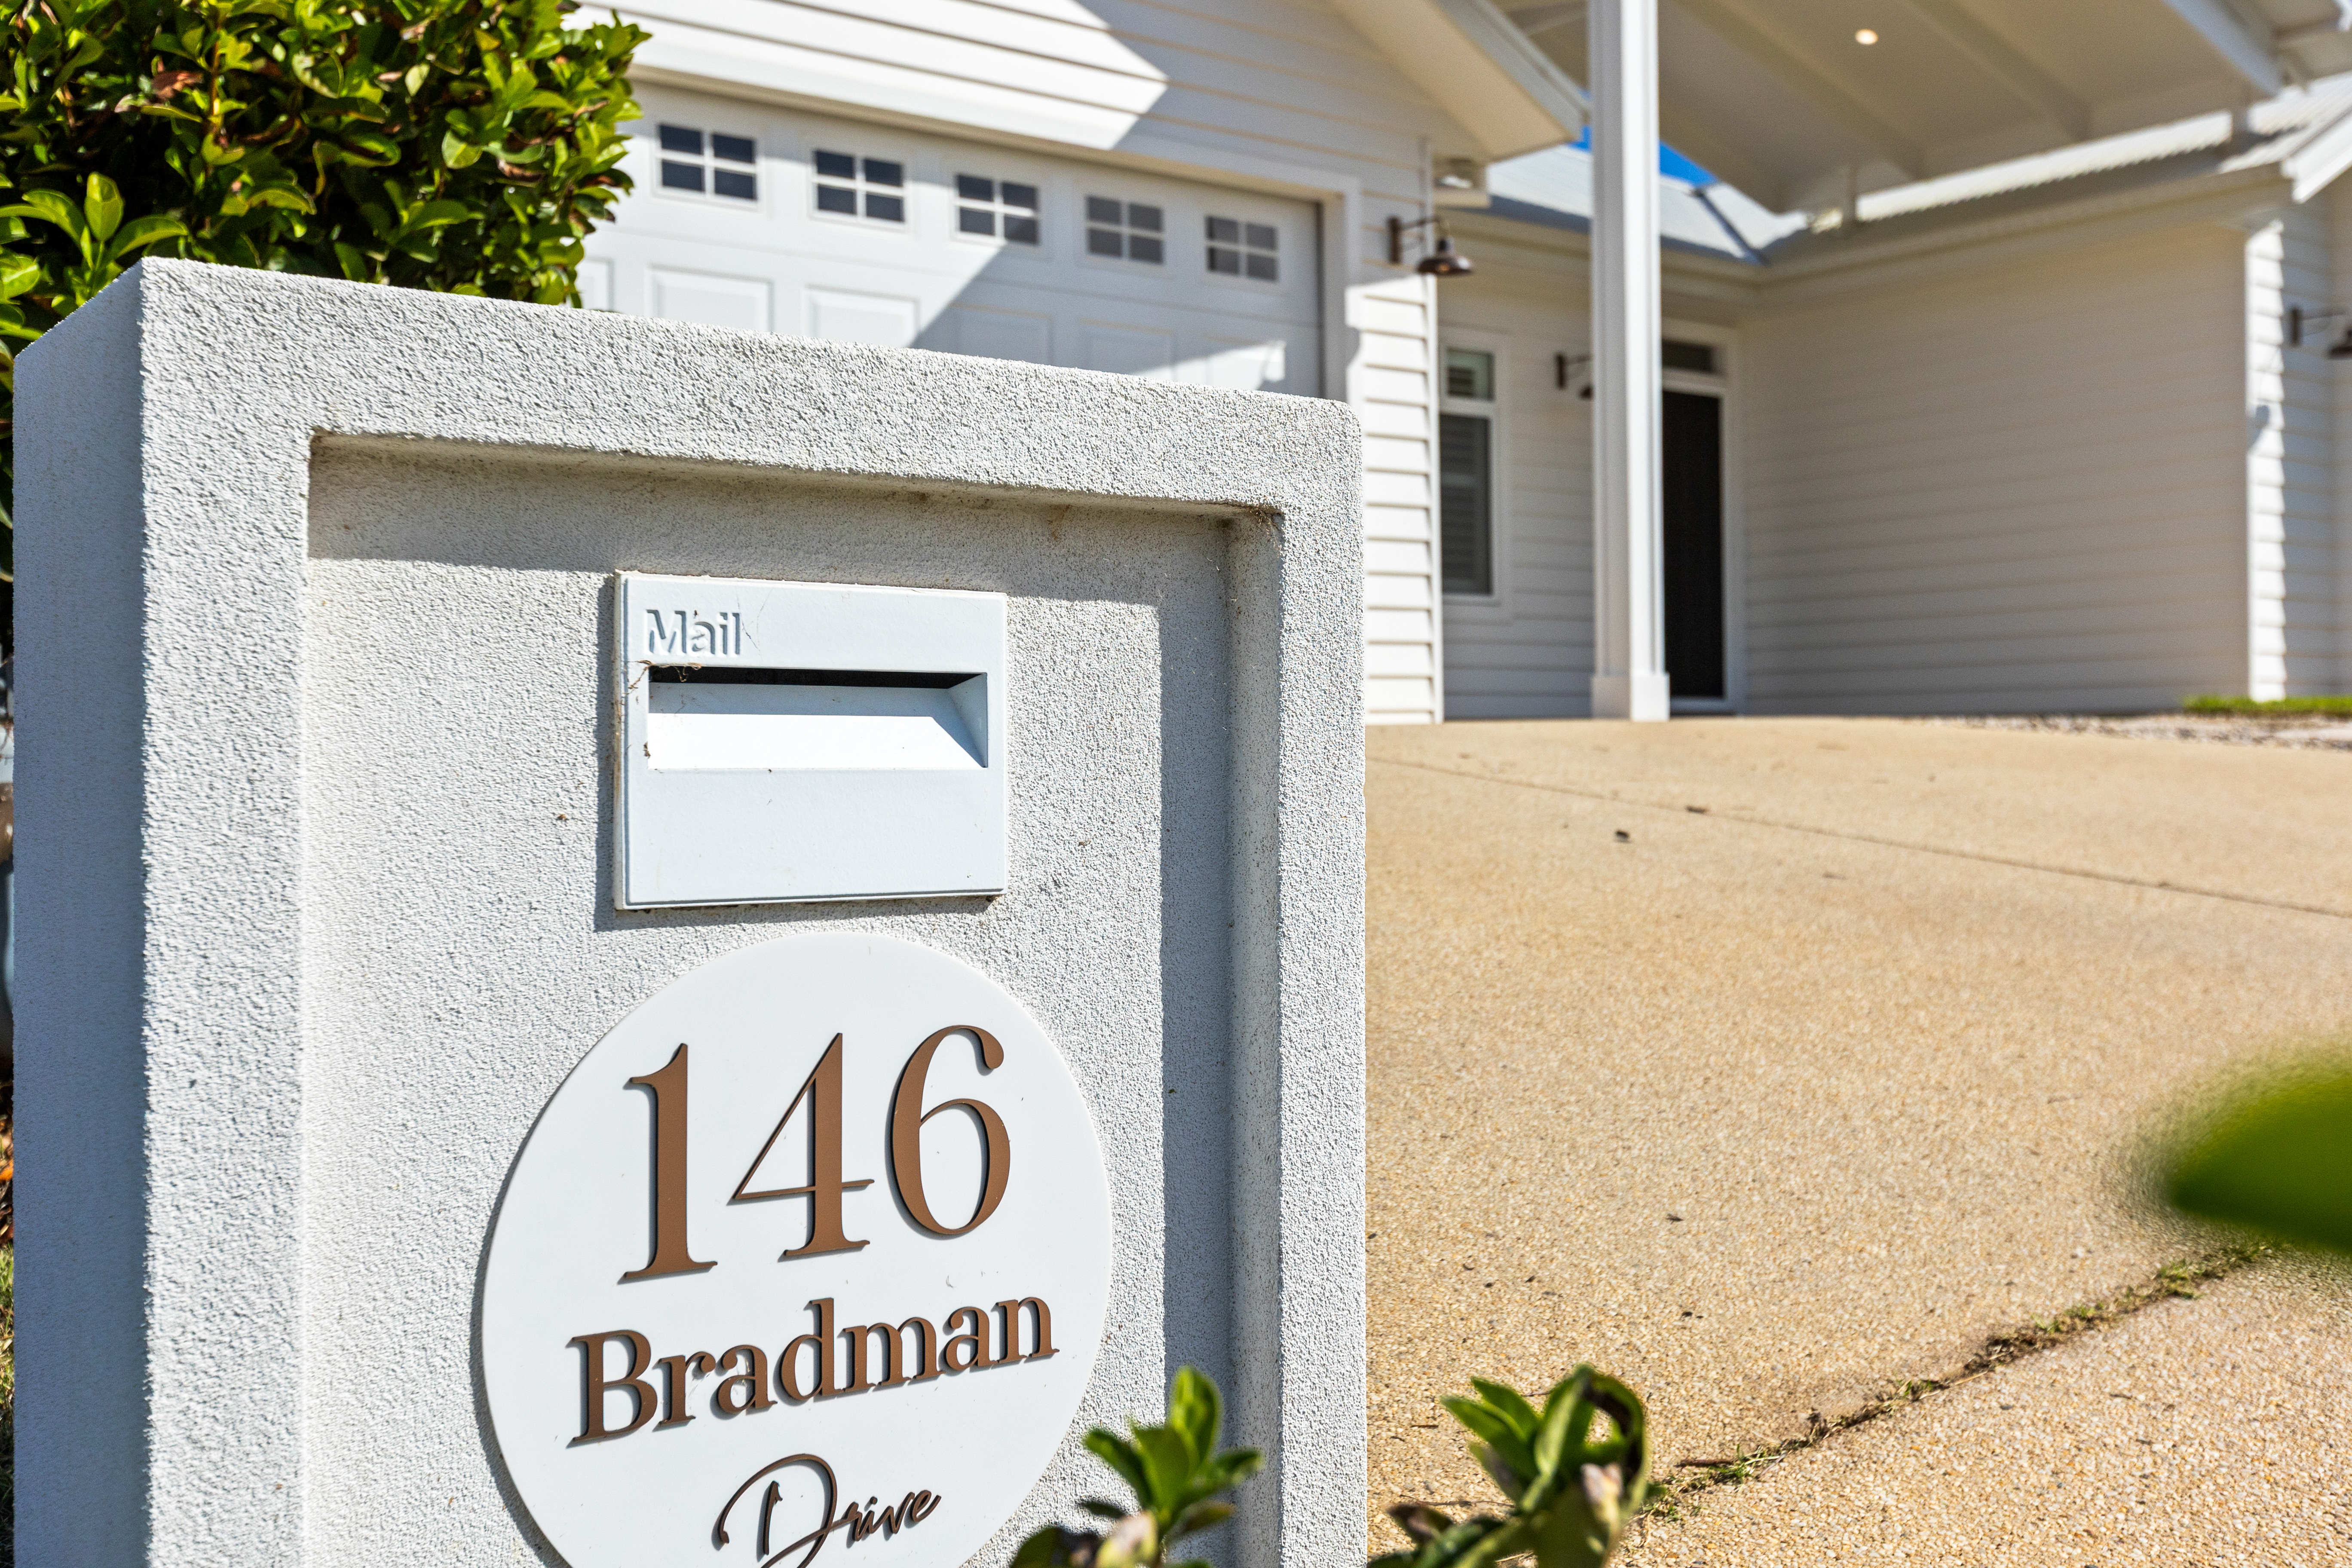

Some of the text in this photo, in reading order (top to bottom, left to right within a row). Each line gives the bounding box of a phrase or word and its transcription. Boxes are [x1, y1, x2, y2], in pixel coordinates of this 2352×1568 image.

[646, 609, 740, 655] Mail
[622, 1024, 1011, 1279] 146
[569, 1297, 1060, 1443] Bradman
[716, 1453, 941, 1568] Drive
